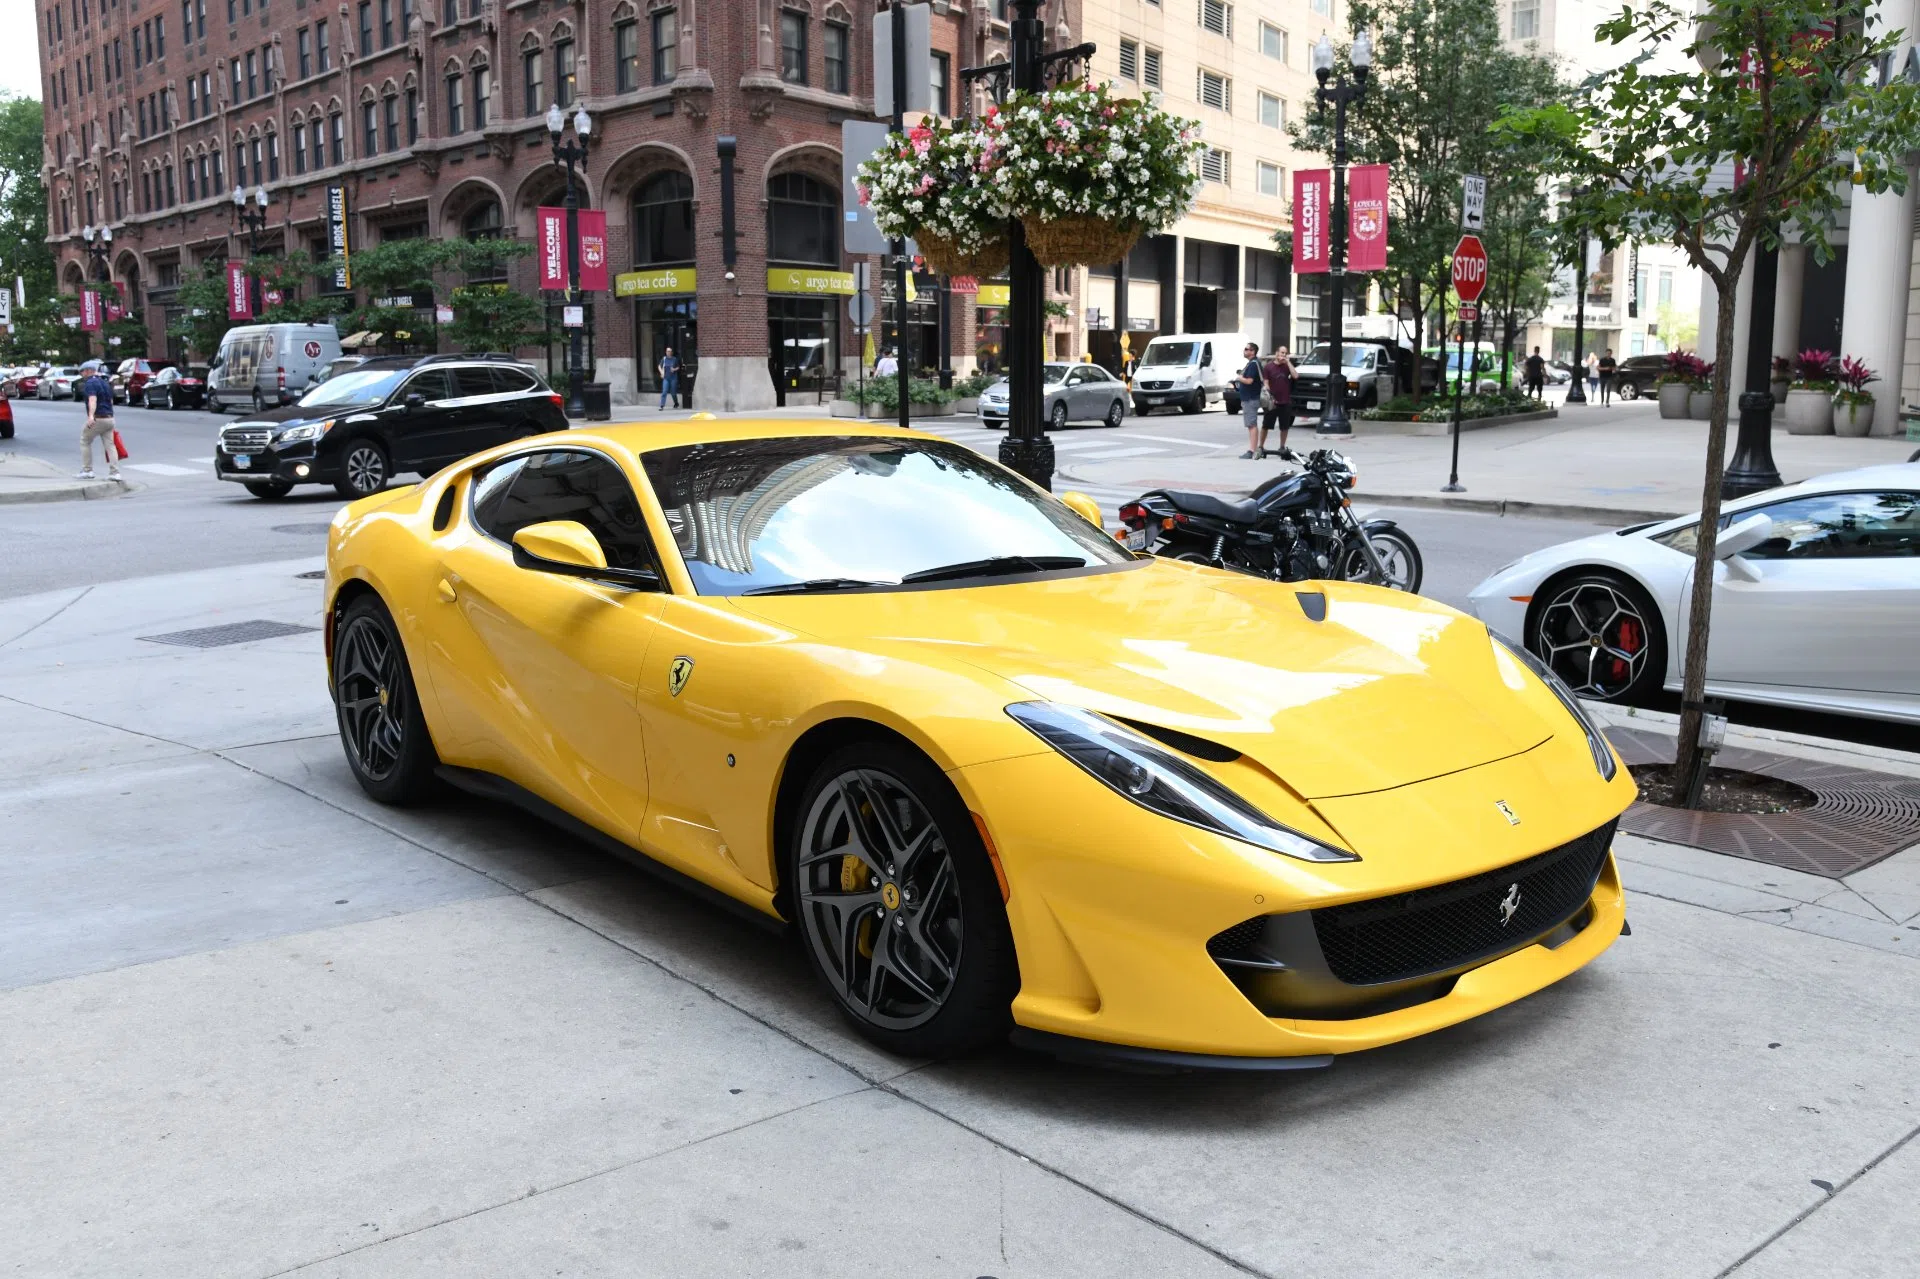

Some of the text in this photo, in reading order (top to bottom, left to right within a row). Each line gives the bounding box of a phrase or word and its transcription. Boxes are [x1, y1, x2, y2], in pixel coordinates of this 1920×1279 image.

[1467, 180, 1483, 195] ONE
[331, 187, 343, 221] BAGELS
[1353, 200, 1383, 208] LOYOLA
[1466, 196, 1482, 208] WAY
[1302, 182, 1313, 260] WELCOME
[546, 217, 556, 279] WELCOME
[336, 248, 346, 288] EINSN
[1454, 256, 1485, 282] STOP
[233, 269, 243, 312] WELCOME
[623, 271, 678, 294] argo tea café
[806, 277, 828, 292] argo
[830, 277, 842, 289] tea
[84, 291, 93, 325] WELCOME
[307, 343, 321, 357] Ayr
